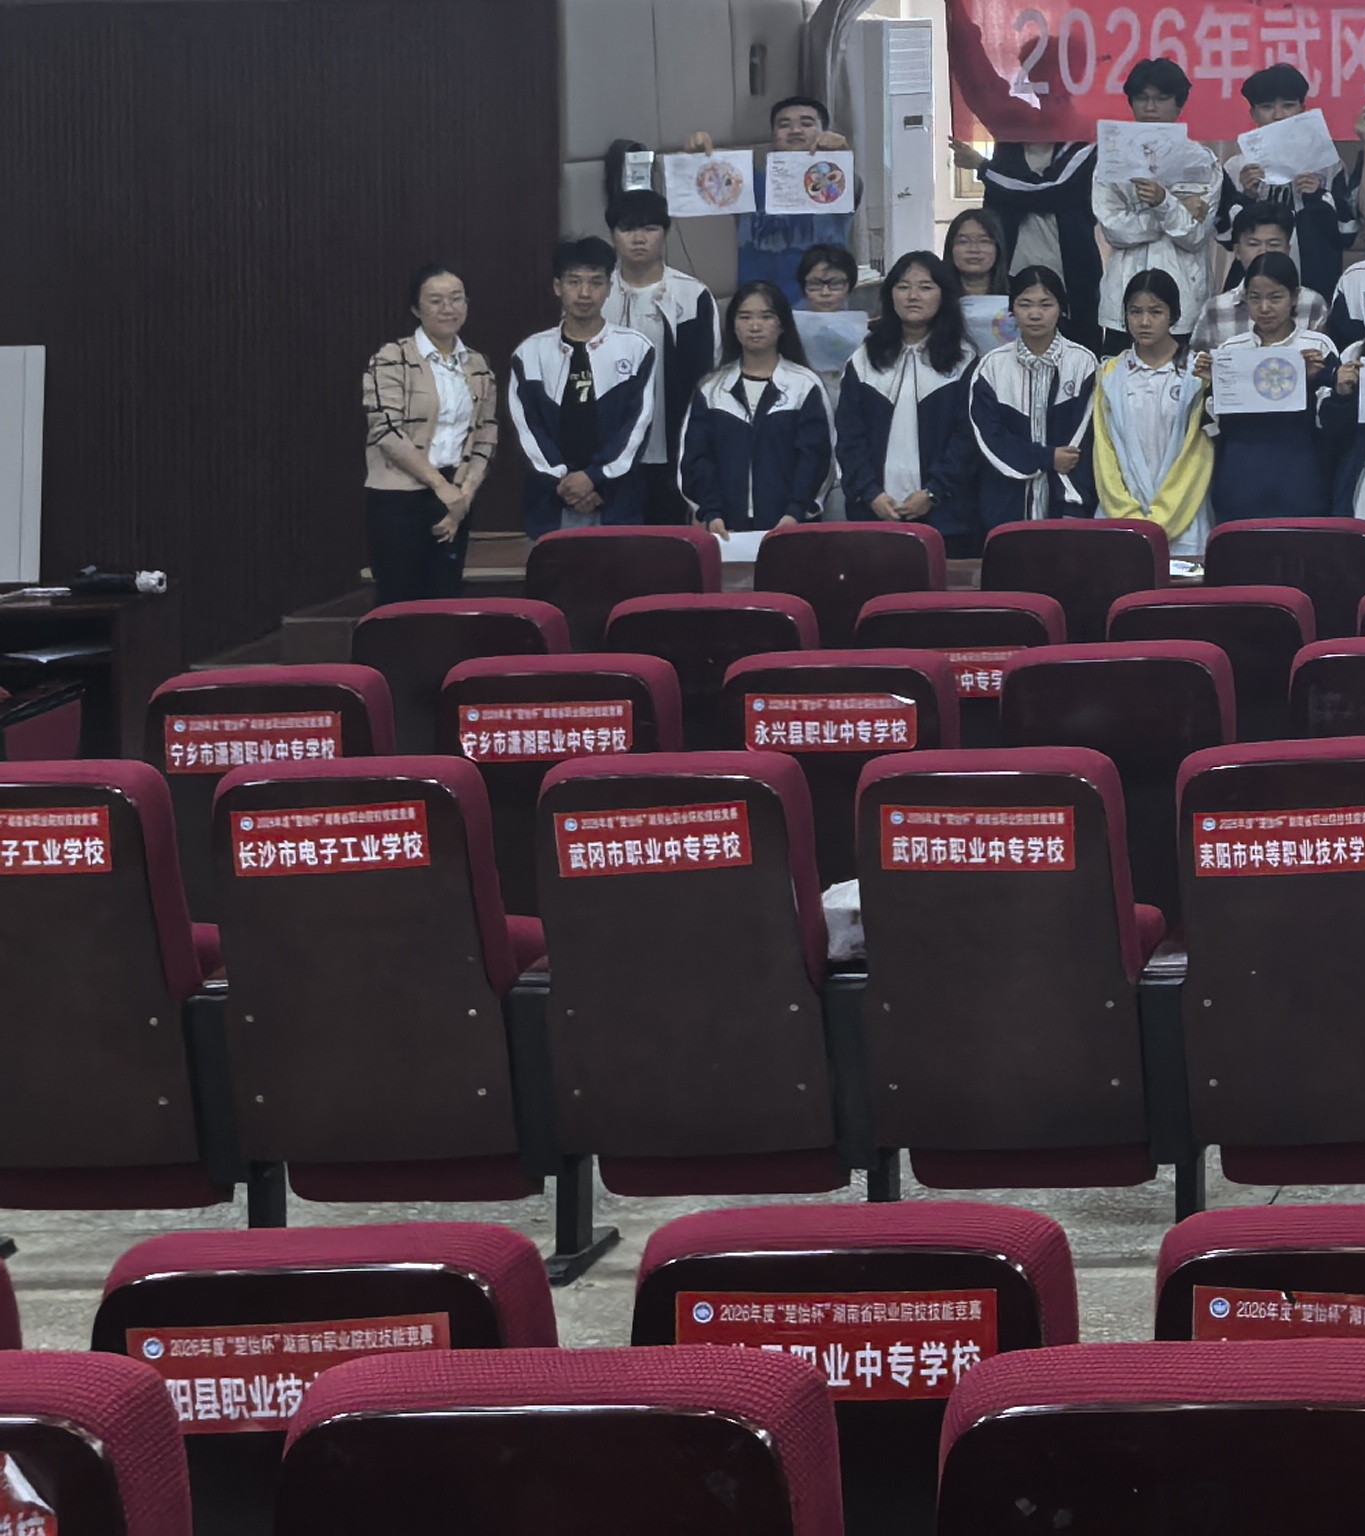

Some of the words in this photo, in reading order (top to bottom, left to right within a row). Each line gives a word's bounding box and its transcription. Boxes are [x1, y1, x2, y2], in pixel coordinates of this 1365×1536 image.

[755, 719, 908, 745] 永兴县职业中专学校
[1, 836, 105, 867] 子工业学校
[239, 831, 424, 869] 长沙市电子工业学校
[568, 832, 742, 869] 武冈市职业中专学校
[892, 836, 1065, 864] 武冈市职业中专学校
